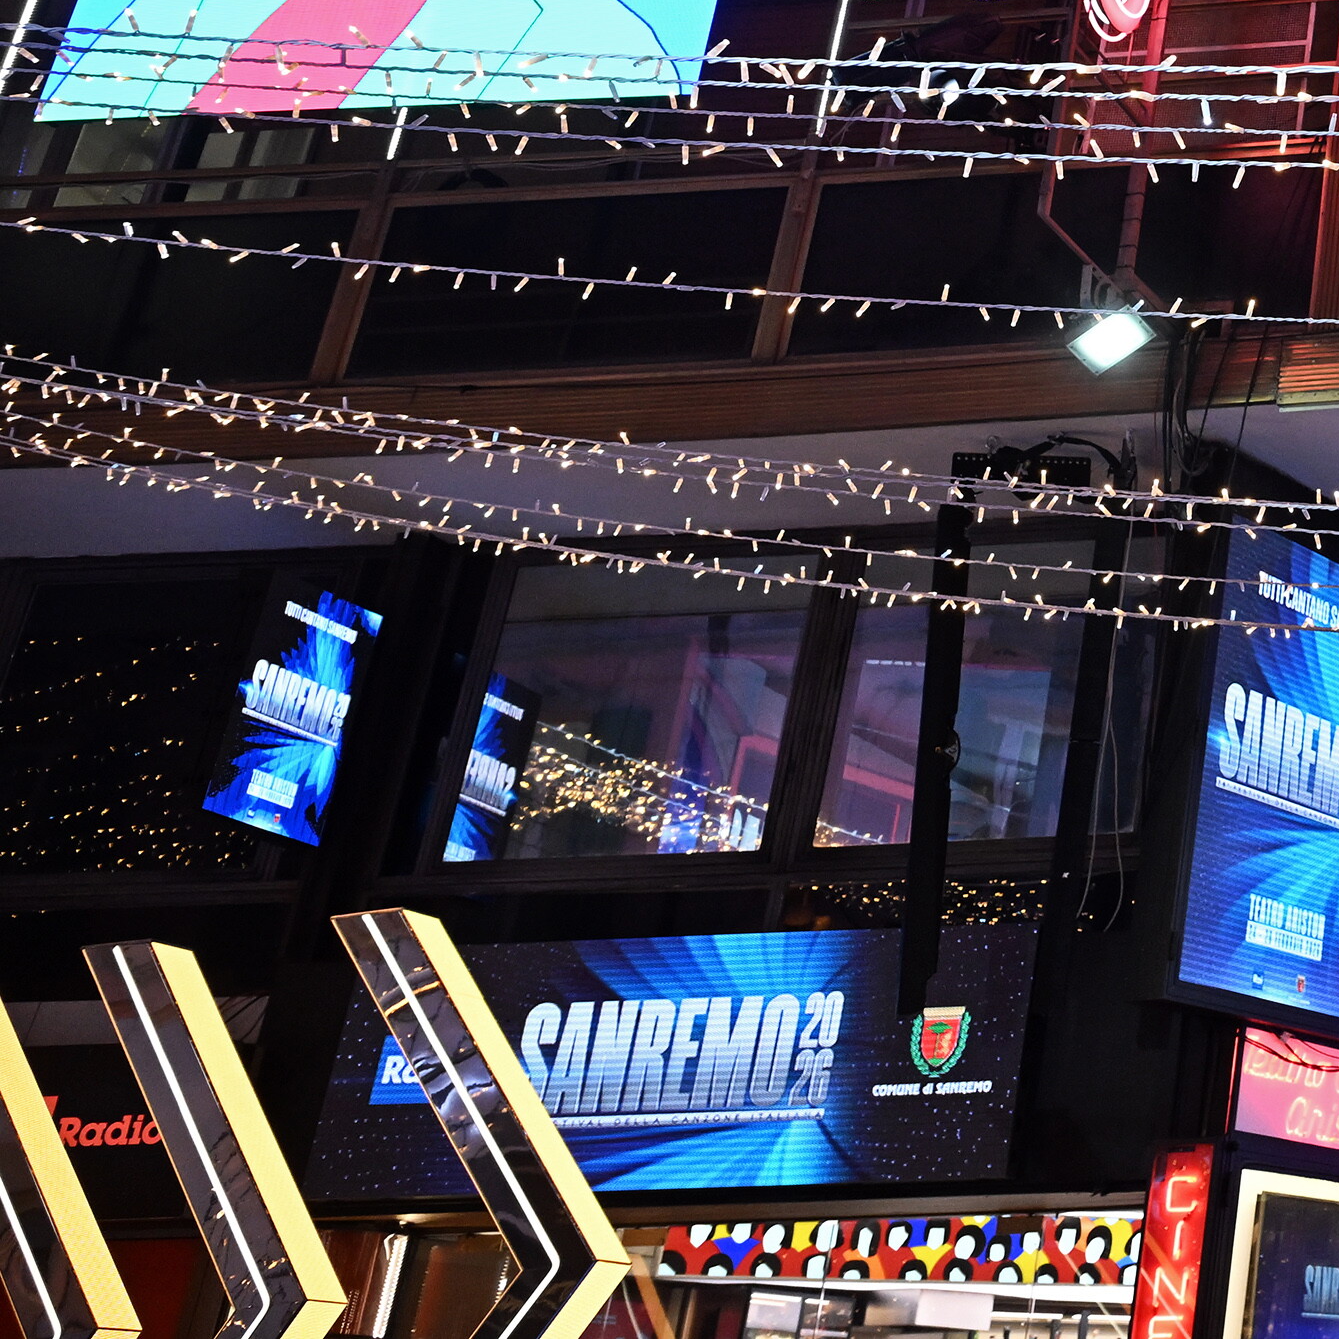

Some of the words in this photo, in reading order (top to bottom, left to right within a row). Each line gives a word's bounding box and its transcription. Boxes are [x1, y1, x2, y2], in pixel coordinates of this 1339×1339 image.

[1285, 585, 1330, 626] CANTANO
[244, 659, 338, 736] SANREMO
[800, 991, 845, 1049] 20
[520, 993, 801, 1114] SANREMO
[872, 1082, 921, 1097] COMUNE
[935, 1080, 993, 1095] SANREMO
[59, 1114, 162, 1148] Radio
